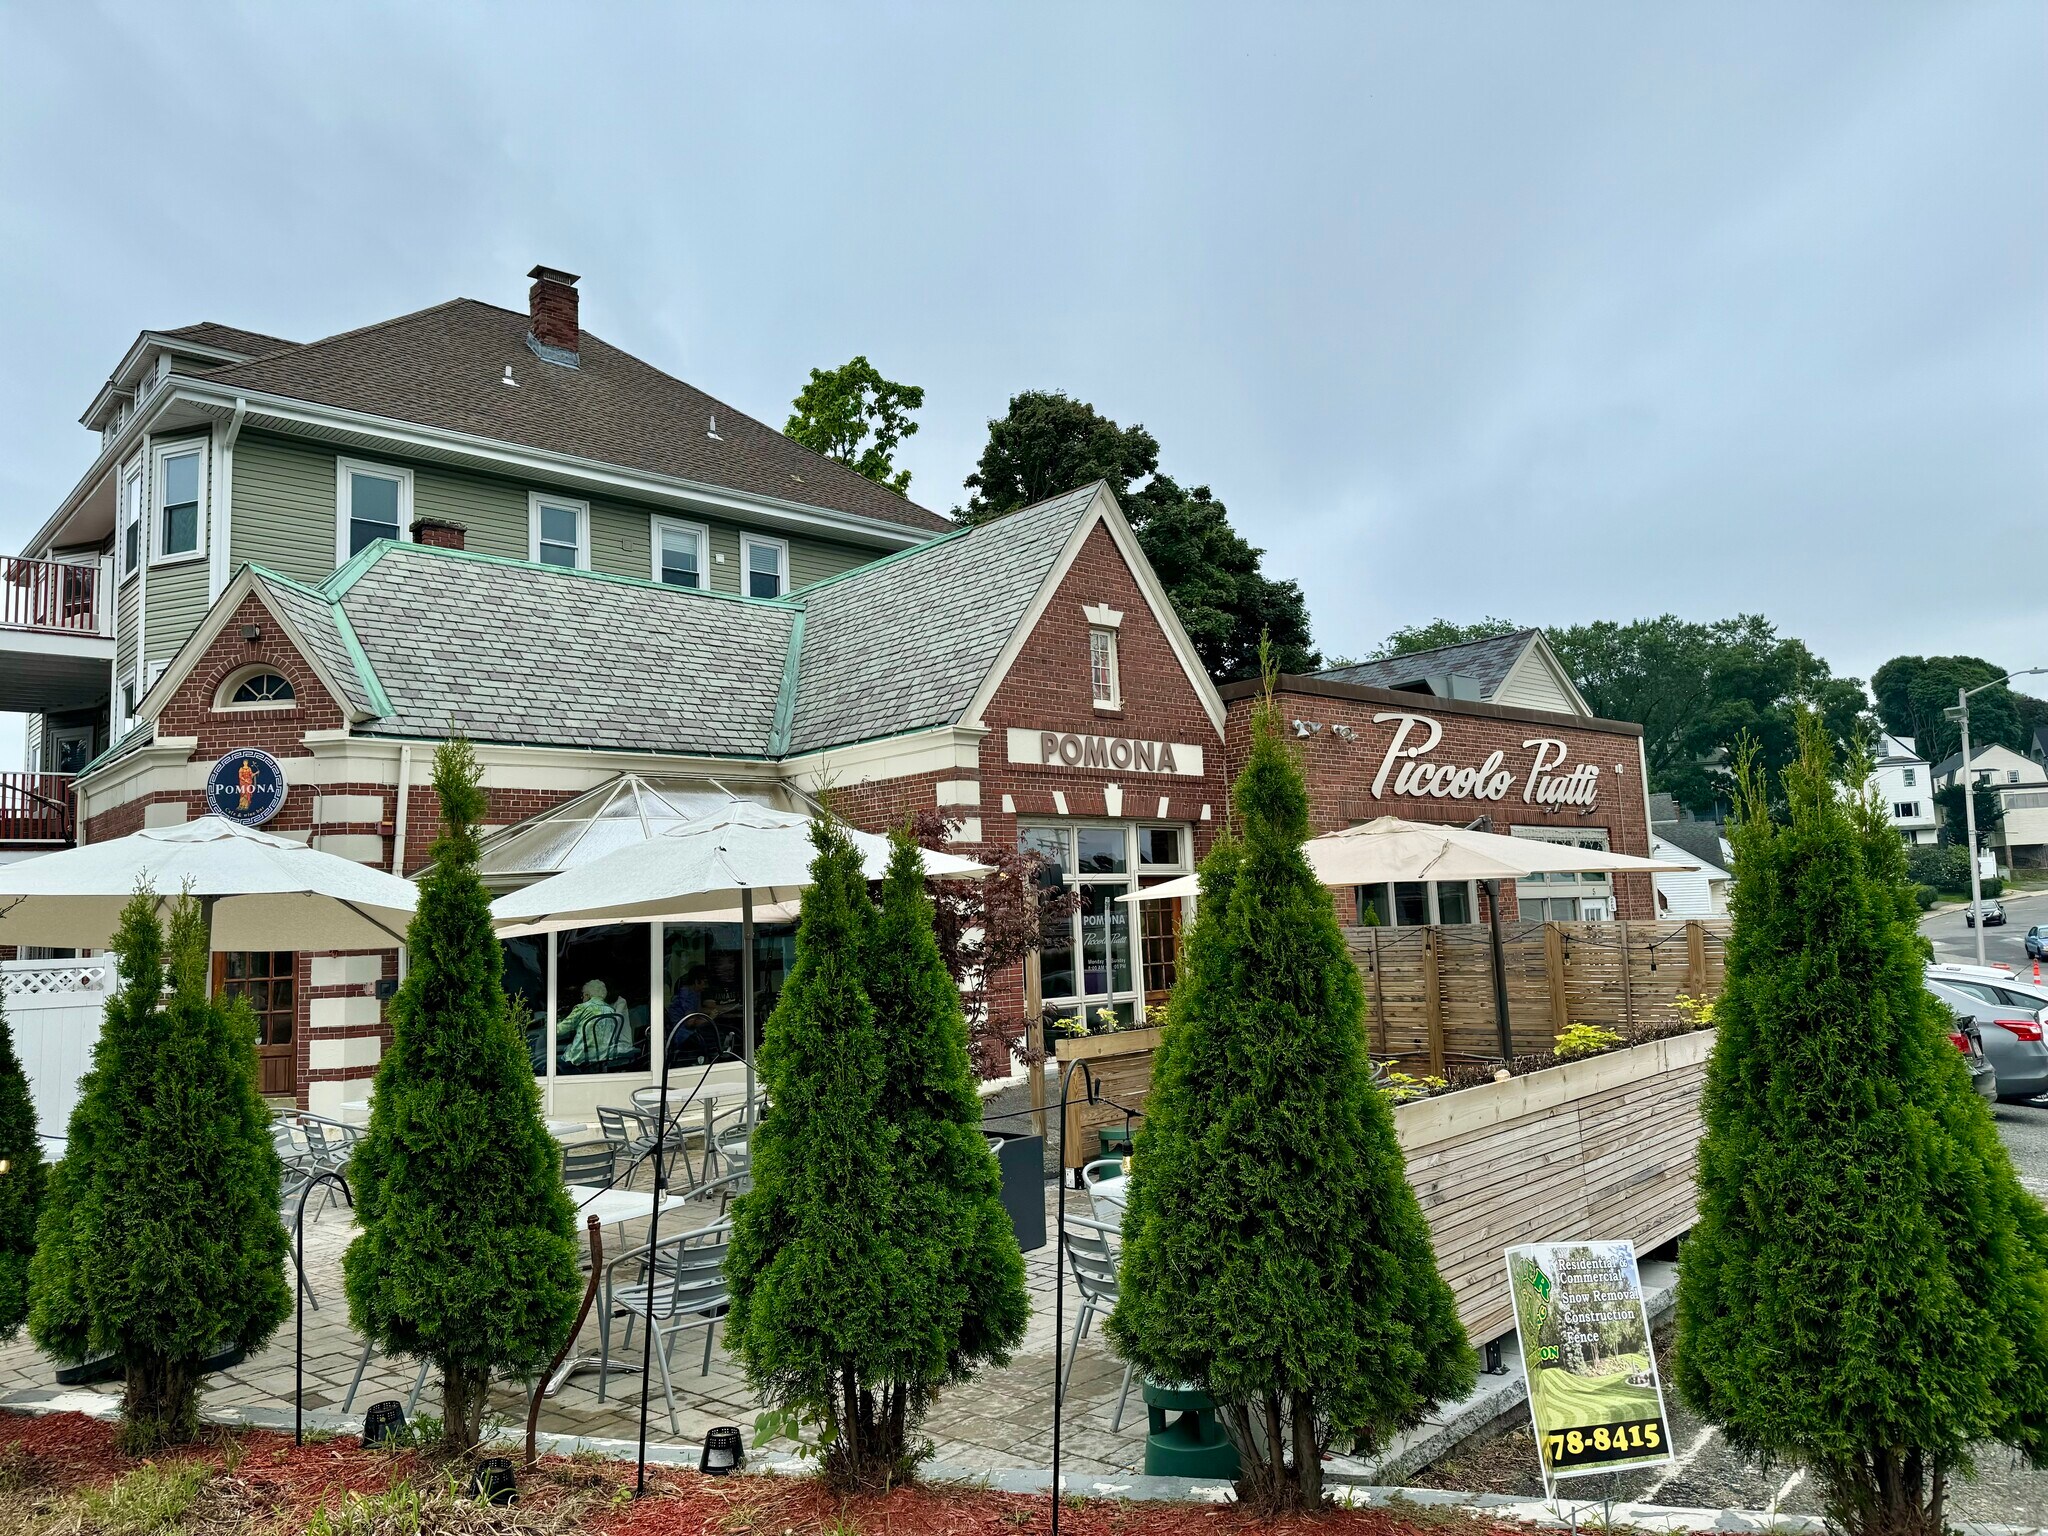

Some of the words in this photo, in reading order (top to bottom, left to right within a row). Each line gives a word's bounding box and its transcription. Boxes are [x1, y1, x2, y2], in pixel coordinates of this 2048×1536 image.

[1041, 731, 1178, 774] POMONA
[1371, 712, 1516, 801] Piccolo
[1522, 738, 1600, 805] Piatti
[215, 783, 275, 795] POMONA
[1083, 915, 1125, 926] POMNA
[1084, 932, 1106, 946] Piccol
[1558, 1255, 1617, 1271] Residential
[1560, 1270, 1622, 1284] Commercial
[1562, 1291, 1590, 1304] Snow
[1593, 1287, 1640, 1302] Removal
[1564, 1309, 1635, 1323] Construction
[1567, 1332, 1600, 1344] Fence
